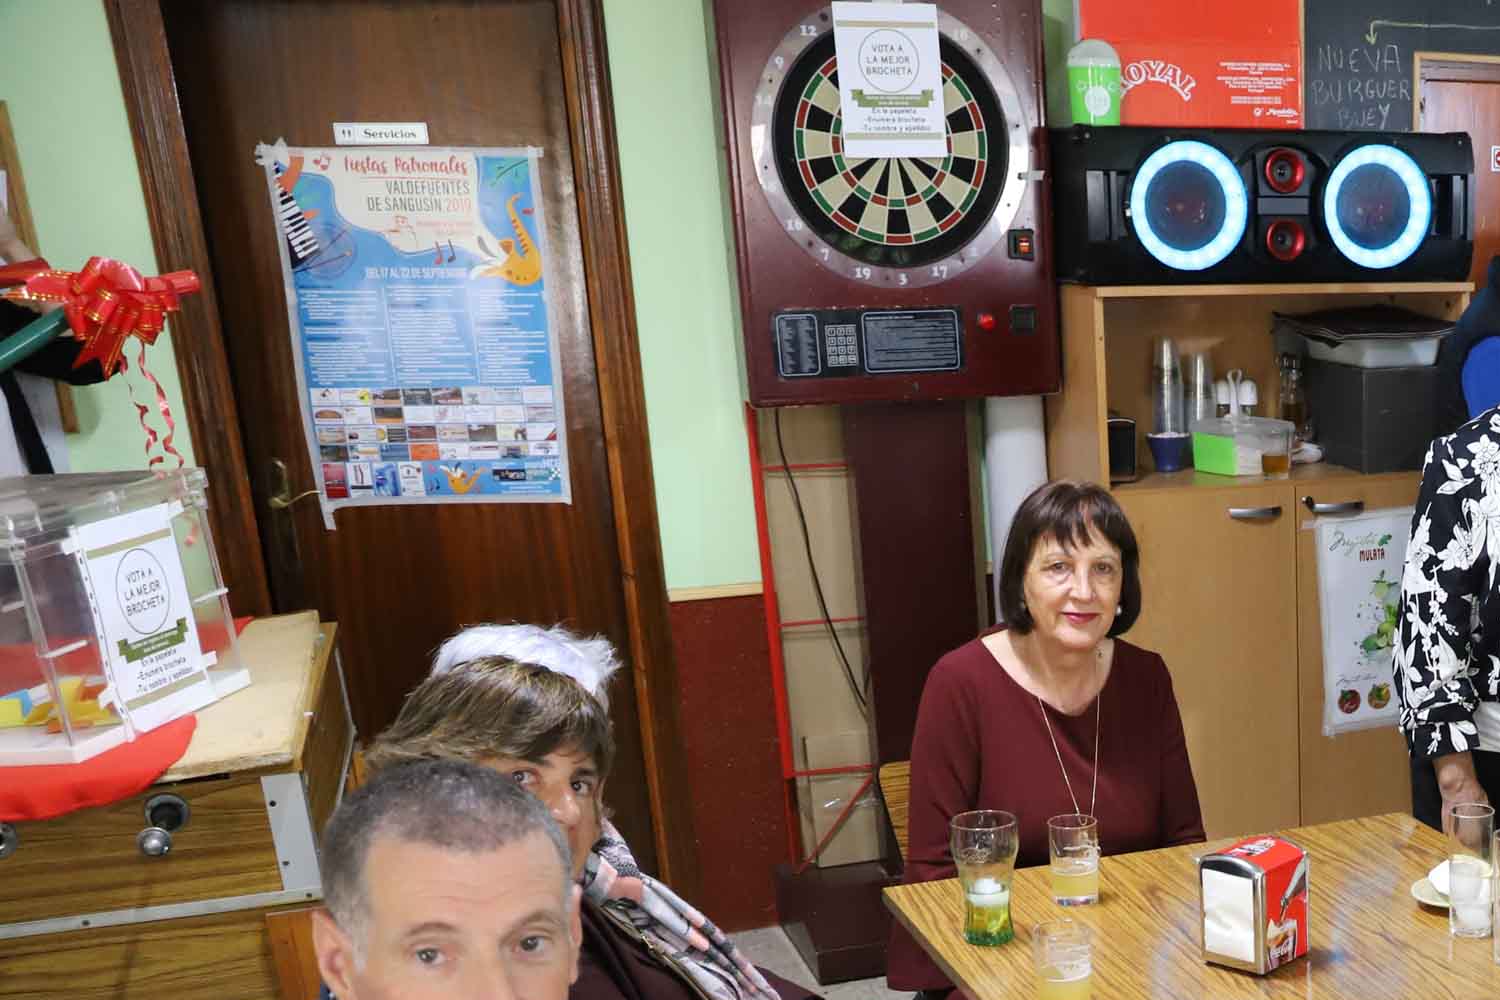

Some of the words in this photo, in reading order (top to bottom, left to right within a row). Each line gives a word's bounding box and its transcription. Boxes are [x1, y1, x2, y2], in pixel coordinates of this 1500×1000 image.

[799, 25, 816, 37] 12
[872, 44, 896, 53] VOTA
[898, 44, 903, 53] A
[774, 56, 784, 69] 9
[866, 56, 878, 65] LA
[880, 56, 910, 65] MEJOR
[1318, 44, 1402, 74] NUEVA
[866, 67, 913, 76] BROCHETA
[1120, 60, 1197, 102] OYAL
[1311, 78, 1411, 104] BURGUER
[363, 128, 417, 139] Servicios
[394, 154, 468, 177] Patronales
[385, 180, 470, 196] VALDEFUENTES
[367, 196, 382, 212] DE
[855, 267, 872, 280] 19
[932, 265, 948, 278] 17
[899, 273, 908, 286] 3
[1359, 547, 1385, 562] MULATA
[127, 570, 146, 584] VOTA
[125, 587, 137, 600] LA
[137, 580, 160, 596] MEJOR
[126, 595, 165, 617] BROCHETA
